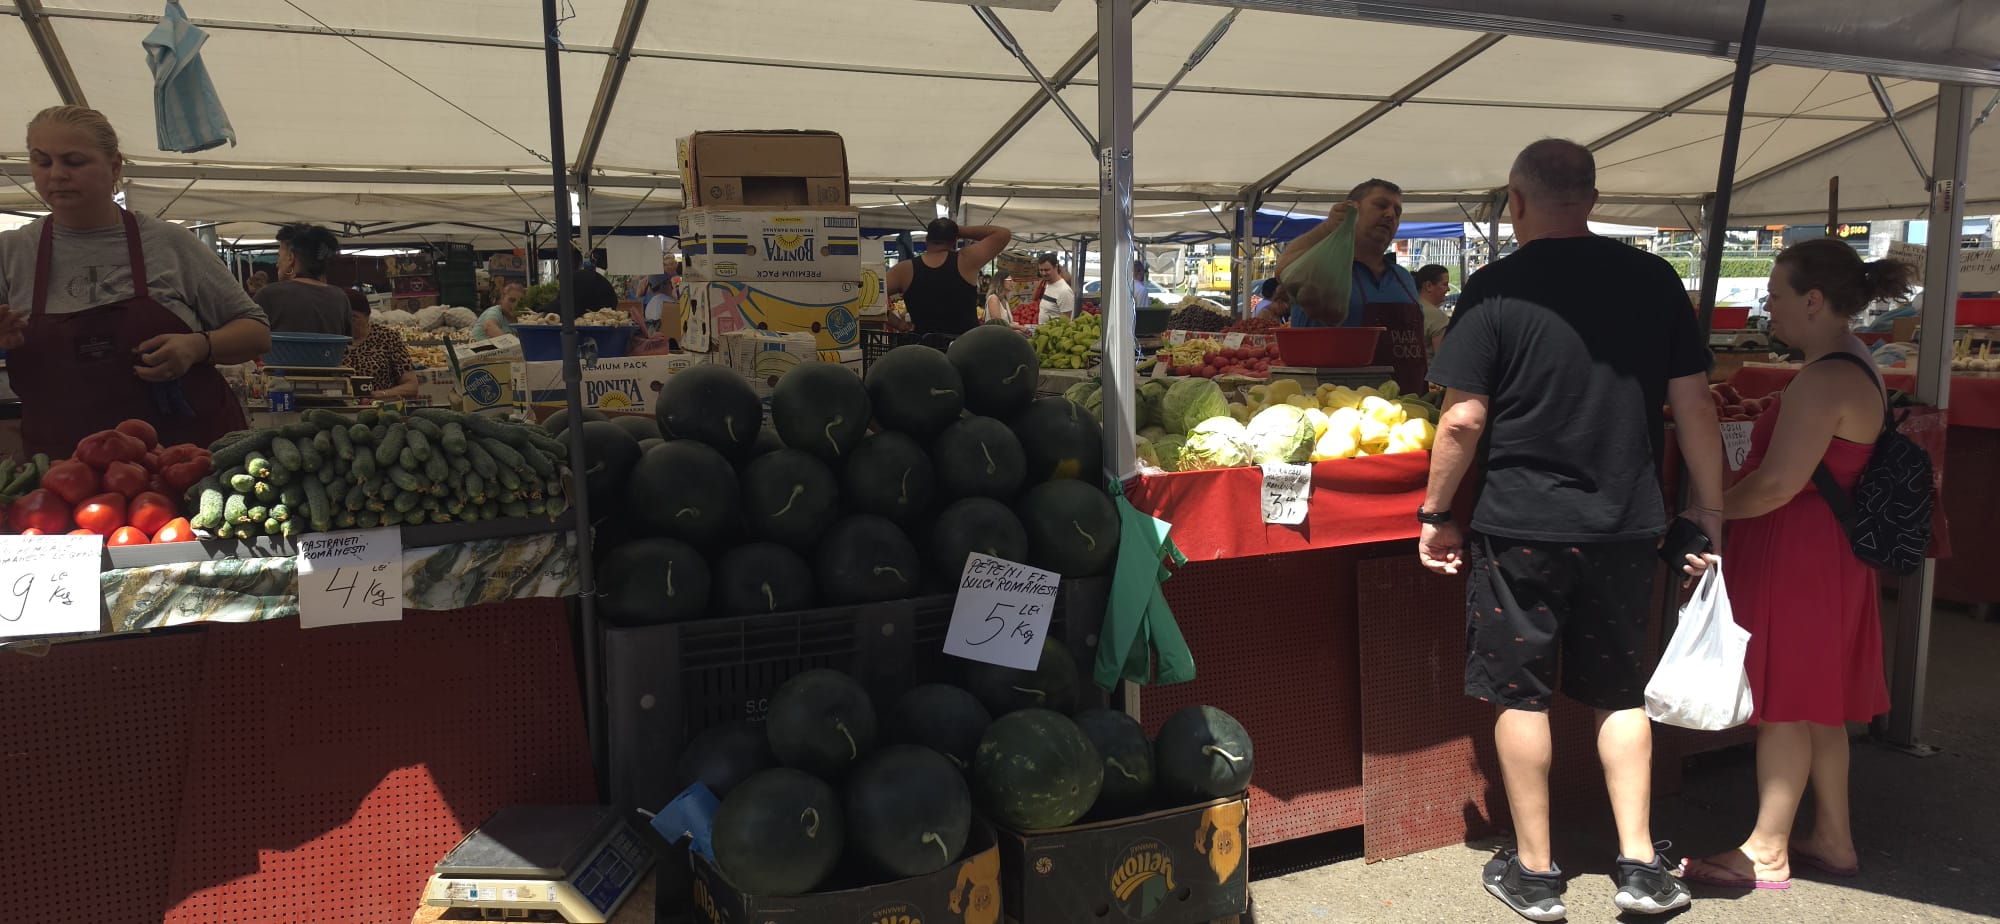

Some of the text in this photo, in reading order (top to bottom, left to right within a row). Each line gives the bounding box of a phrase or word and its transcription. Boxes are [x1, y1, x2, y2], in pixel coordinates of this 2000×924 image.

[763, 238, 815, 262] BONITA
[756, 270, 822, 278] PREMIUM PACK
[624, 361, 648, 369] PACK
[585, 379, 645, 406] BONITA
[1735, 447, 1745, 466] 6
[326, 567, 396, 608] 4 Kg
[966, 602, 1016, 646] 5
[1010, 620, 1034, 645] Kg
